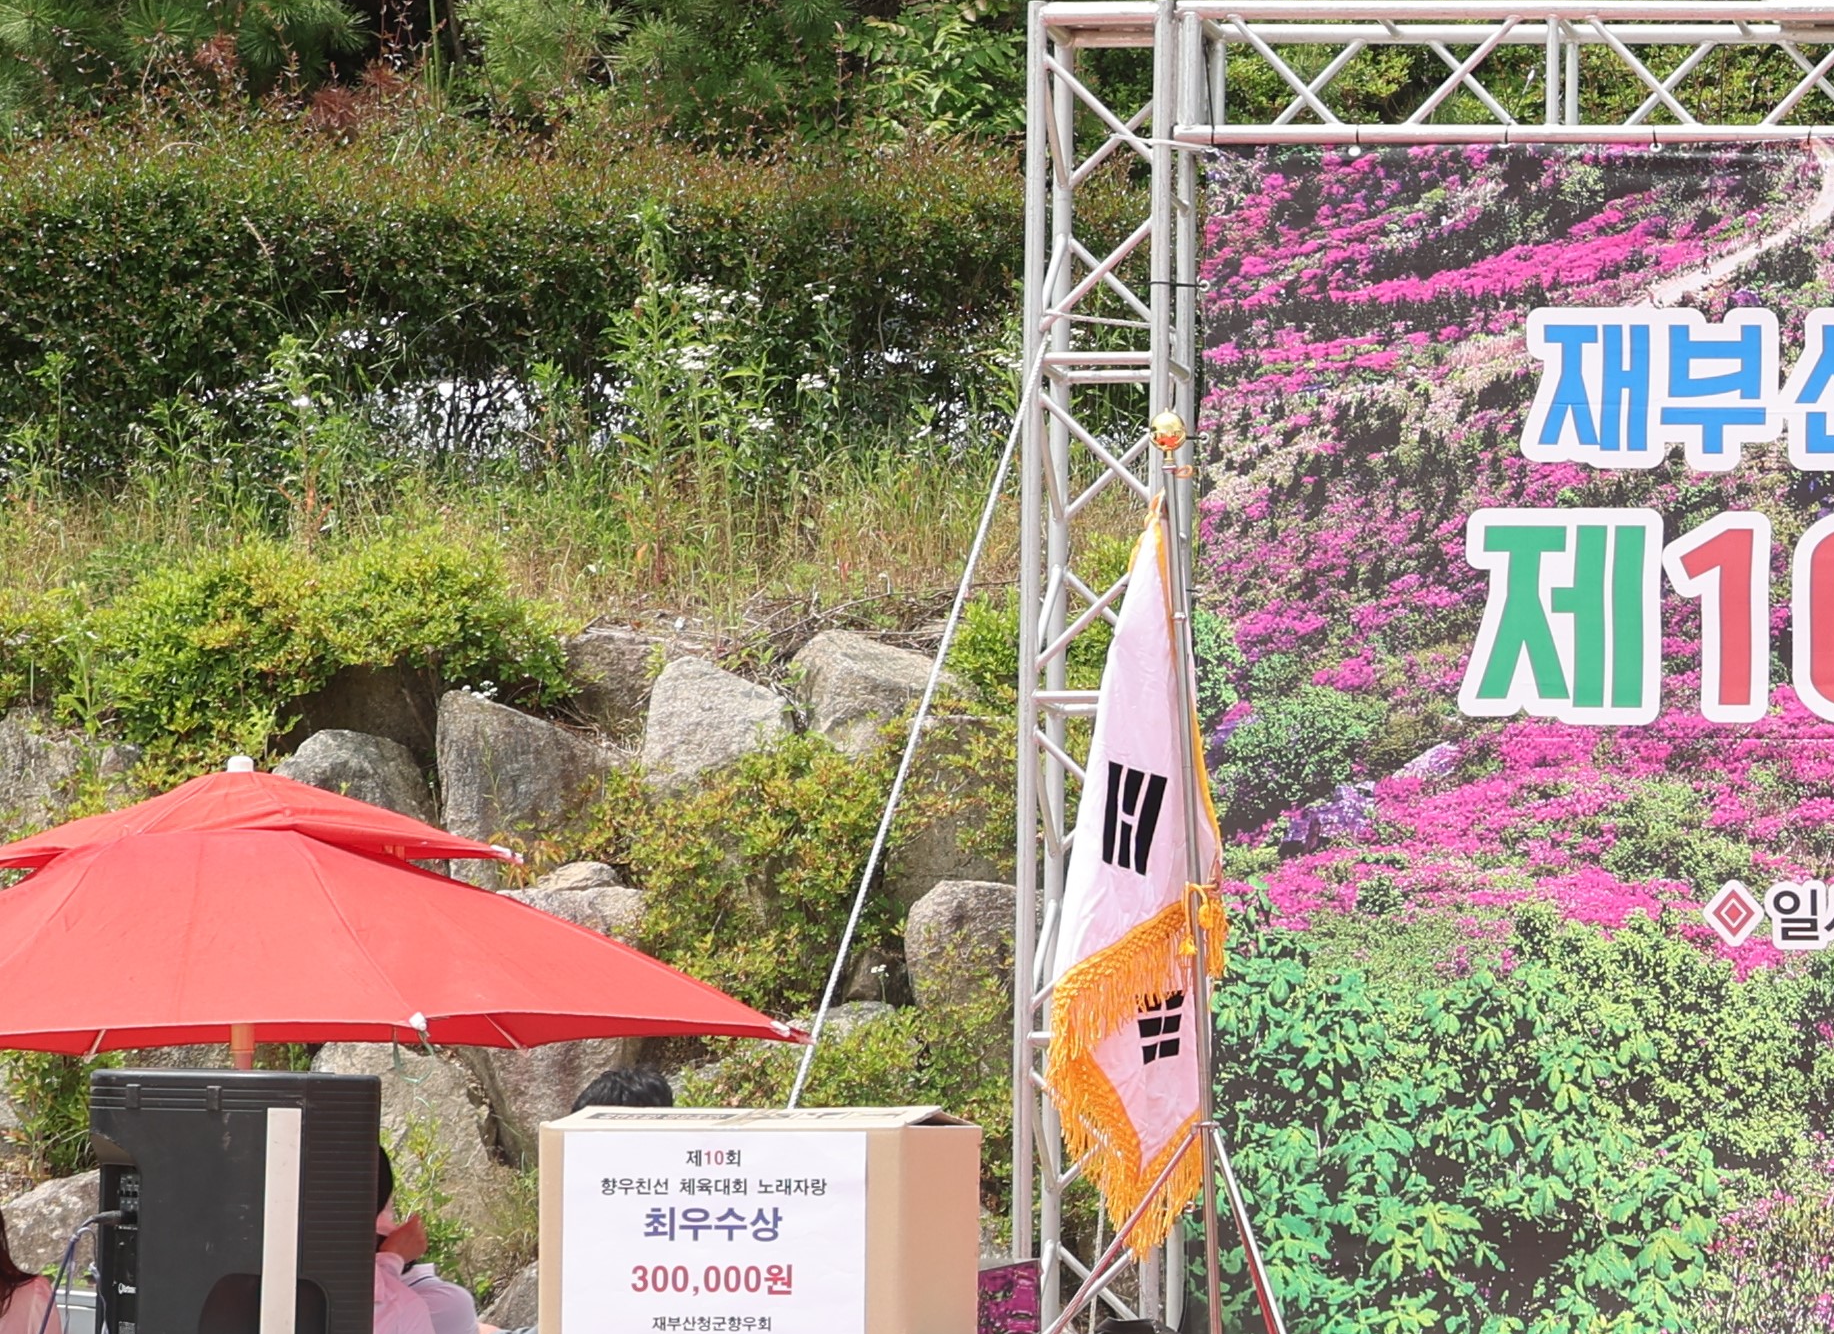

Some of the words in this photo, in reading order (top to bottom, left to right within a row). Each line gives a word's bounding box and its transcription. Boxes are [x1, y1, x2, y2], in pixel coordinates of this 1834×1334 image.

[686, 1150, 741, 1167] 제10회
[601, 1178, 668, 1195] 향우친선
[680, 1178, 747, 1195] 체육대회
[758, 1178, 827, 1196] 노래자랑
[644, 1207, 783, 1242] 최우수상
[631, 1264, 792, 1296] 300,000원
[652, 1316, 771, 1331] 재부산청군향우회
